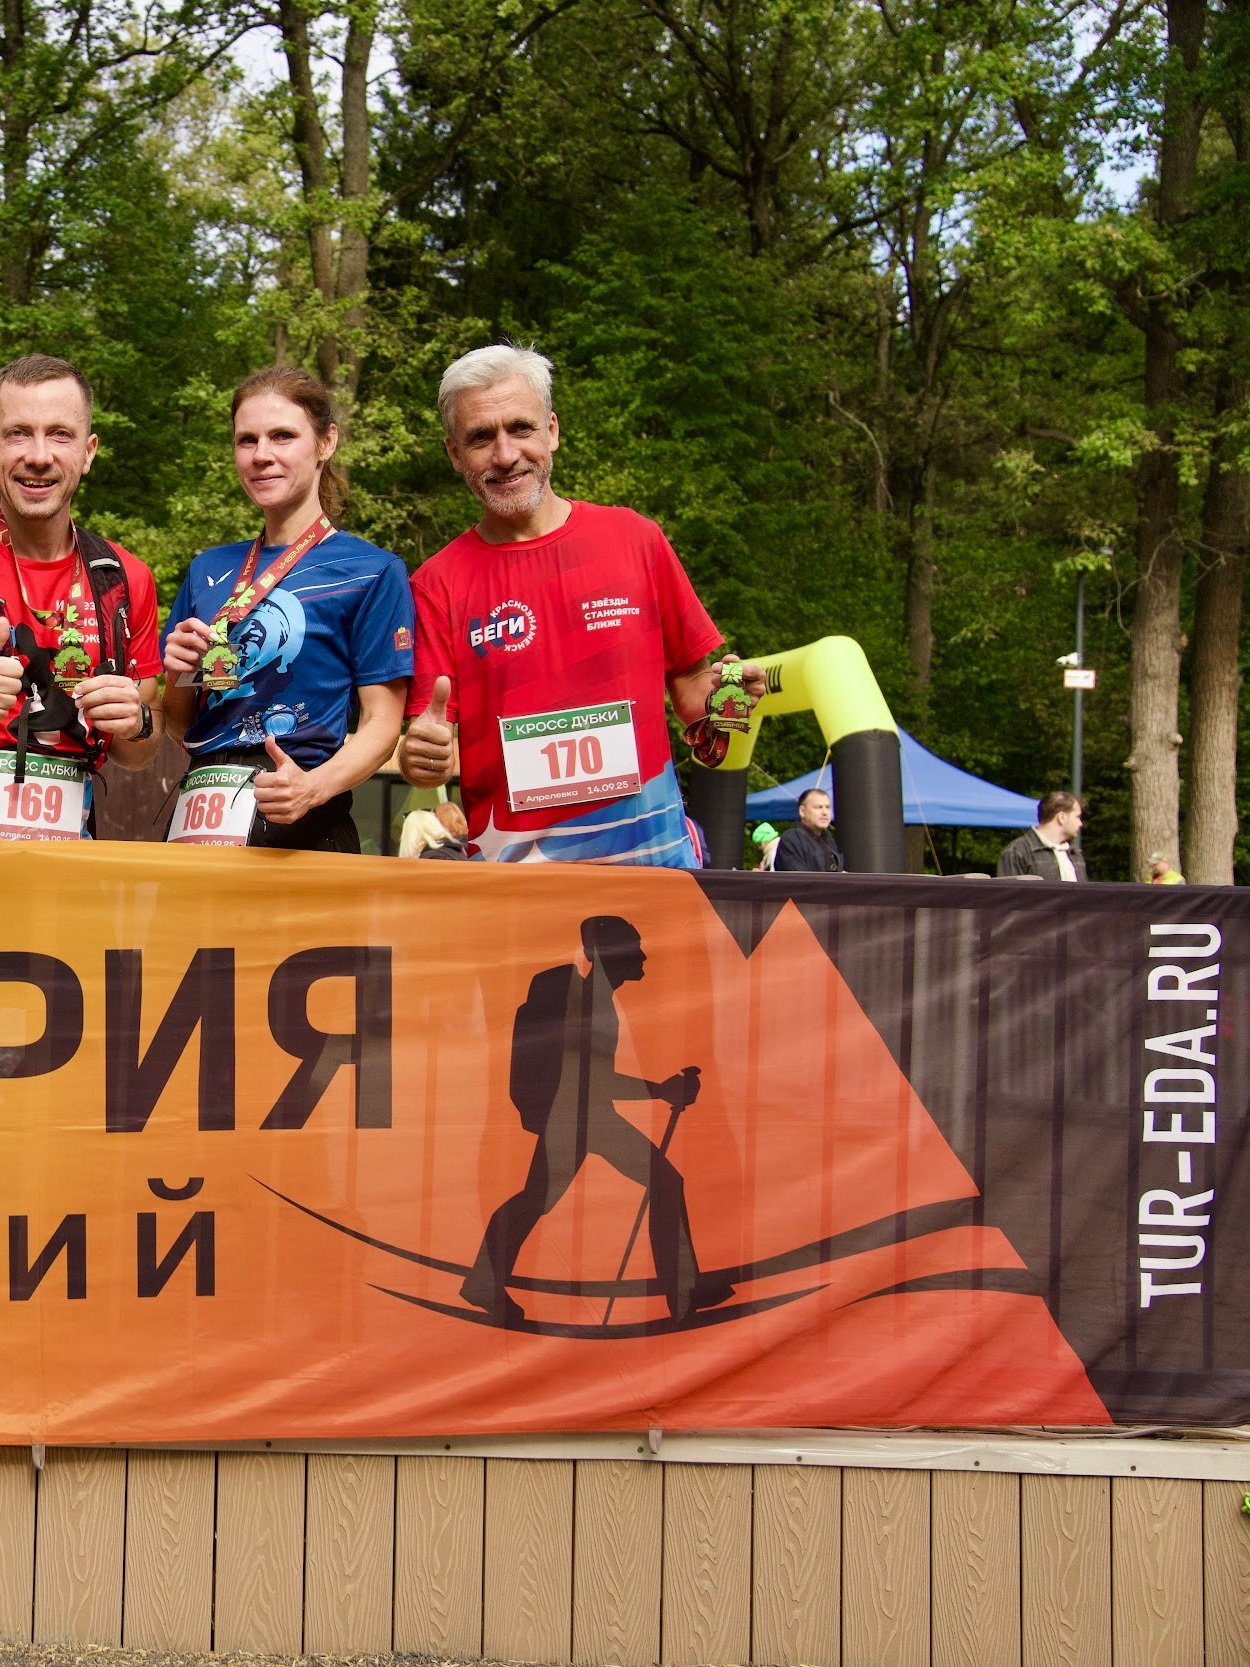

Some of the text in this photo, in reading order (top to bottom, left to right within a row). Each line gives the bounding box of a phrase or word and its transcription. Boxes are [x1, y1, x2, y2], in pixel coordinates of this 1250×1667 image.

[582, 598, 629, 610] И ЗВЁЗДЫ
[584, 607, 640, 620] СТАНОВЯТСЯ
[470, 616, 525, 647] БЕГИ
[490, 600, 537, 652] КРАСНОЗНАМЕНСК
[586, 618, 622, 631] БЛИЖЕ
[515, 709, 619, 736] КРОСС ДУБКИ
[40, 763, 78, 778] ДУБКИ
[540, 735, 604, 780] 170
[207, 772, 248, 785] ДУБКИ
[525, 780, 629, 804] Апрелевка 14.09.25
[3, 782, 63, 824] 169
[183, 792, 226, 831] 168
[1138, 923, 1222, 1308] TUR-EDA.RU
